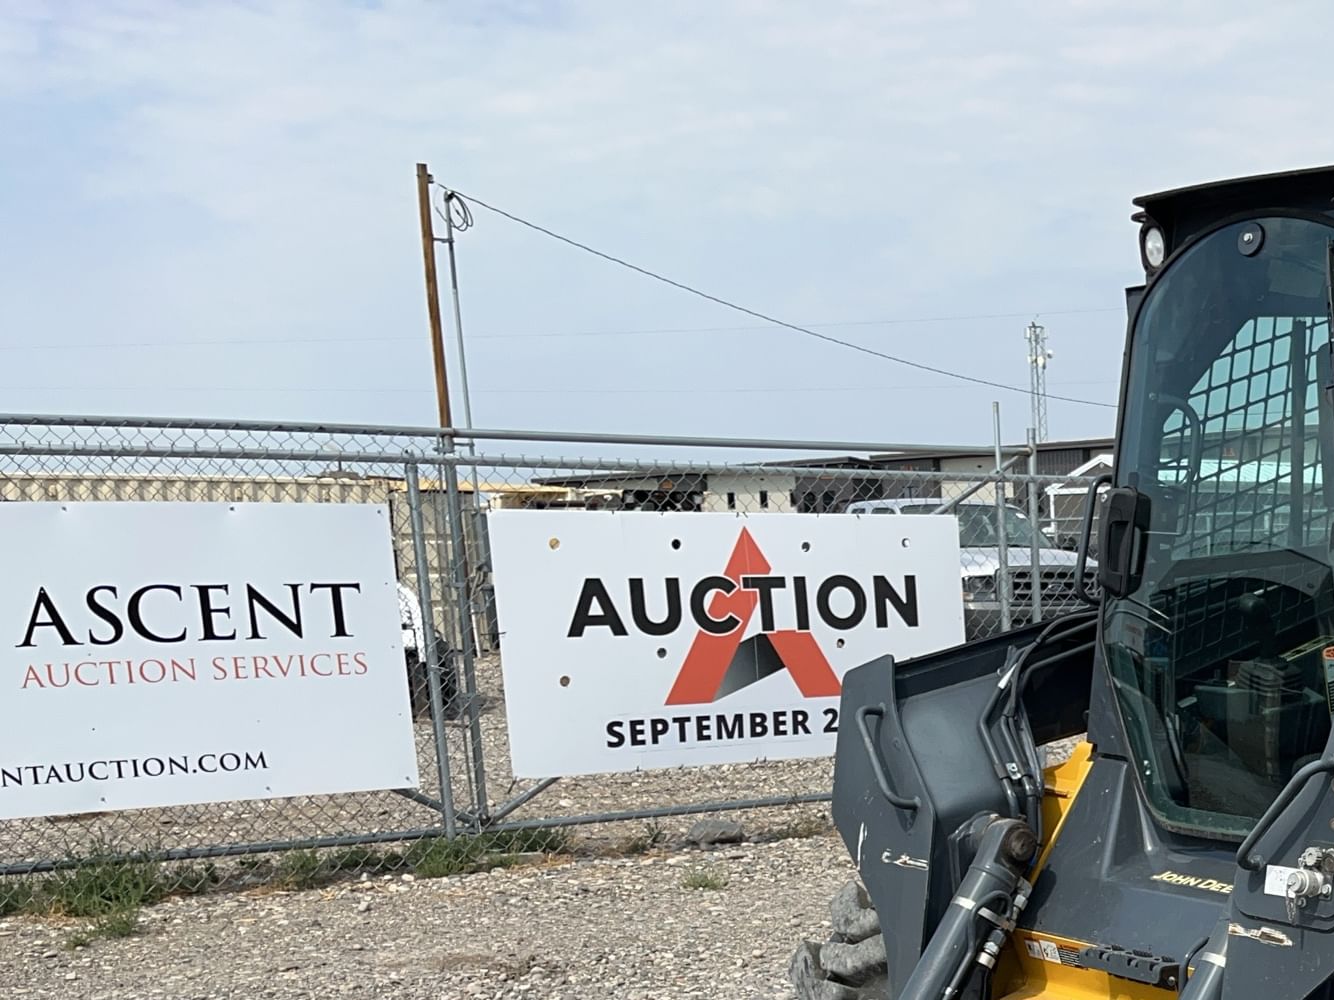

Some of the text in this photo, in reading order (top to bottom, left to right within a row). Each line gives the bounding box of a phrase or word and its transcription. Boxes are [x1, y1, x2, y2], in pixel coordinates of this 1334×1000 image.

[15, 582, 361, 648] ASCENT
[567, 573, 919, 638] AUCTION
[21, 652, 369, 690] AUCTION SERVICES
[606, 707, 839, 749] SEPTEMBER 2
[0, 751, 269, 788] NTAUCTION.COM
[1150, 870, 1202, 886] JOHN
